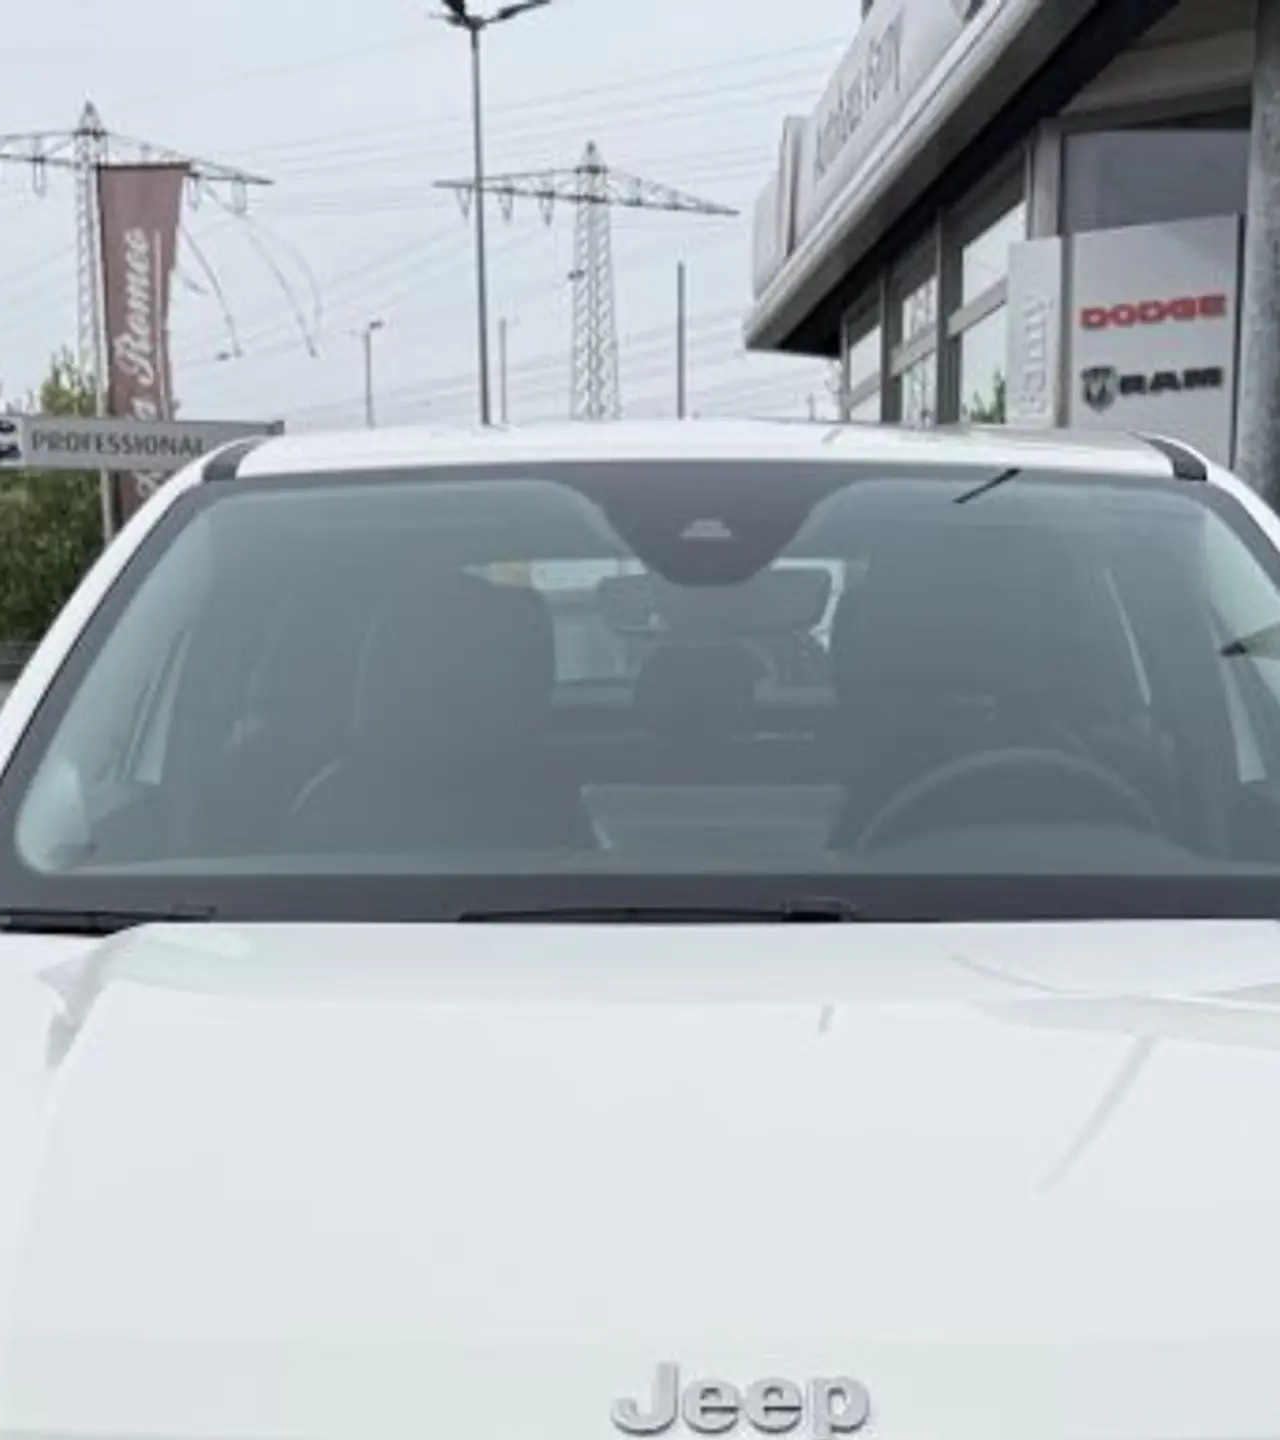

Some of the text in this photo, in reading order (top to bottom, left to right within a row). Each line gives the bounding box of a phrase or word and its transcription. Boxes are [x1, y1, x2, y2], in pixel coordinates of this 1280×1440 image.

[1080, 294, 1226, 329] DODGE
[1119, 367, 1224, 396] RAM
[31, 430, 204, 456] PROFESSIONAL
